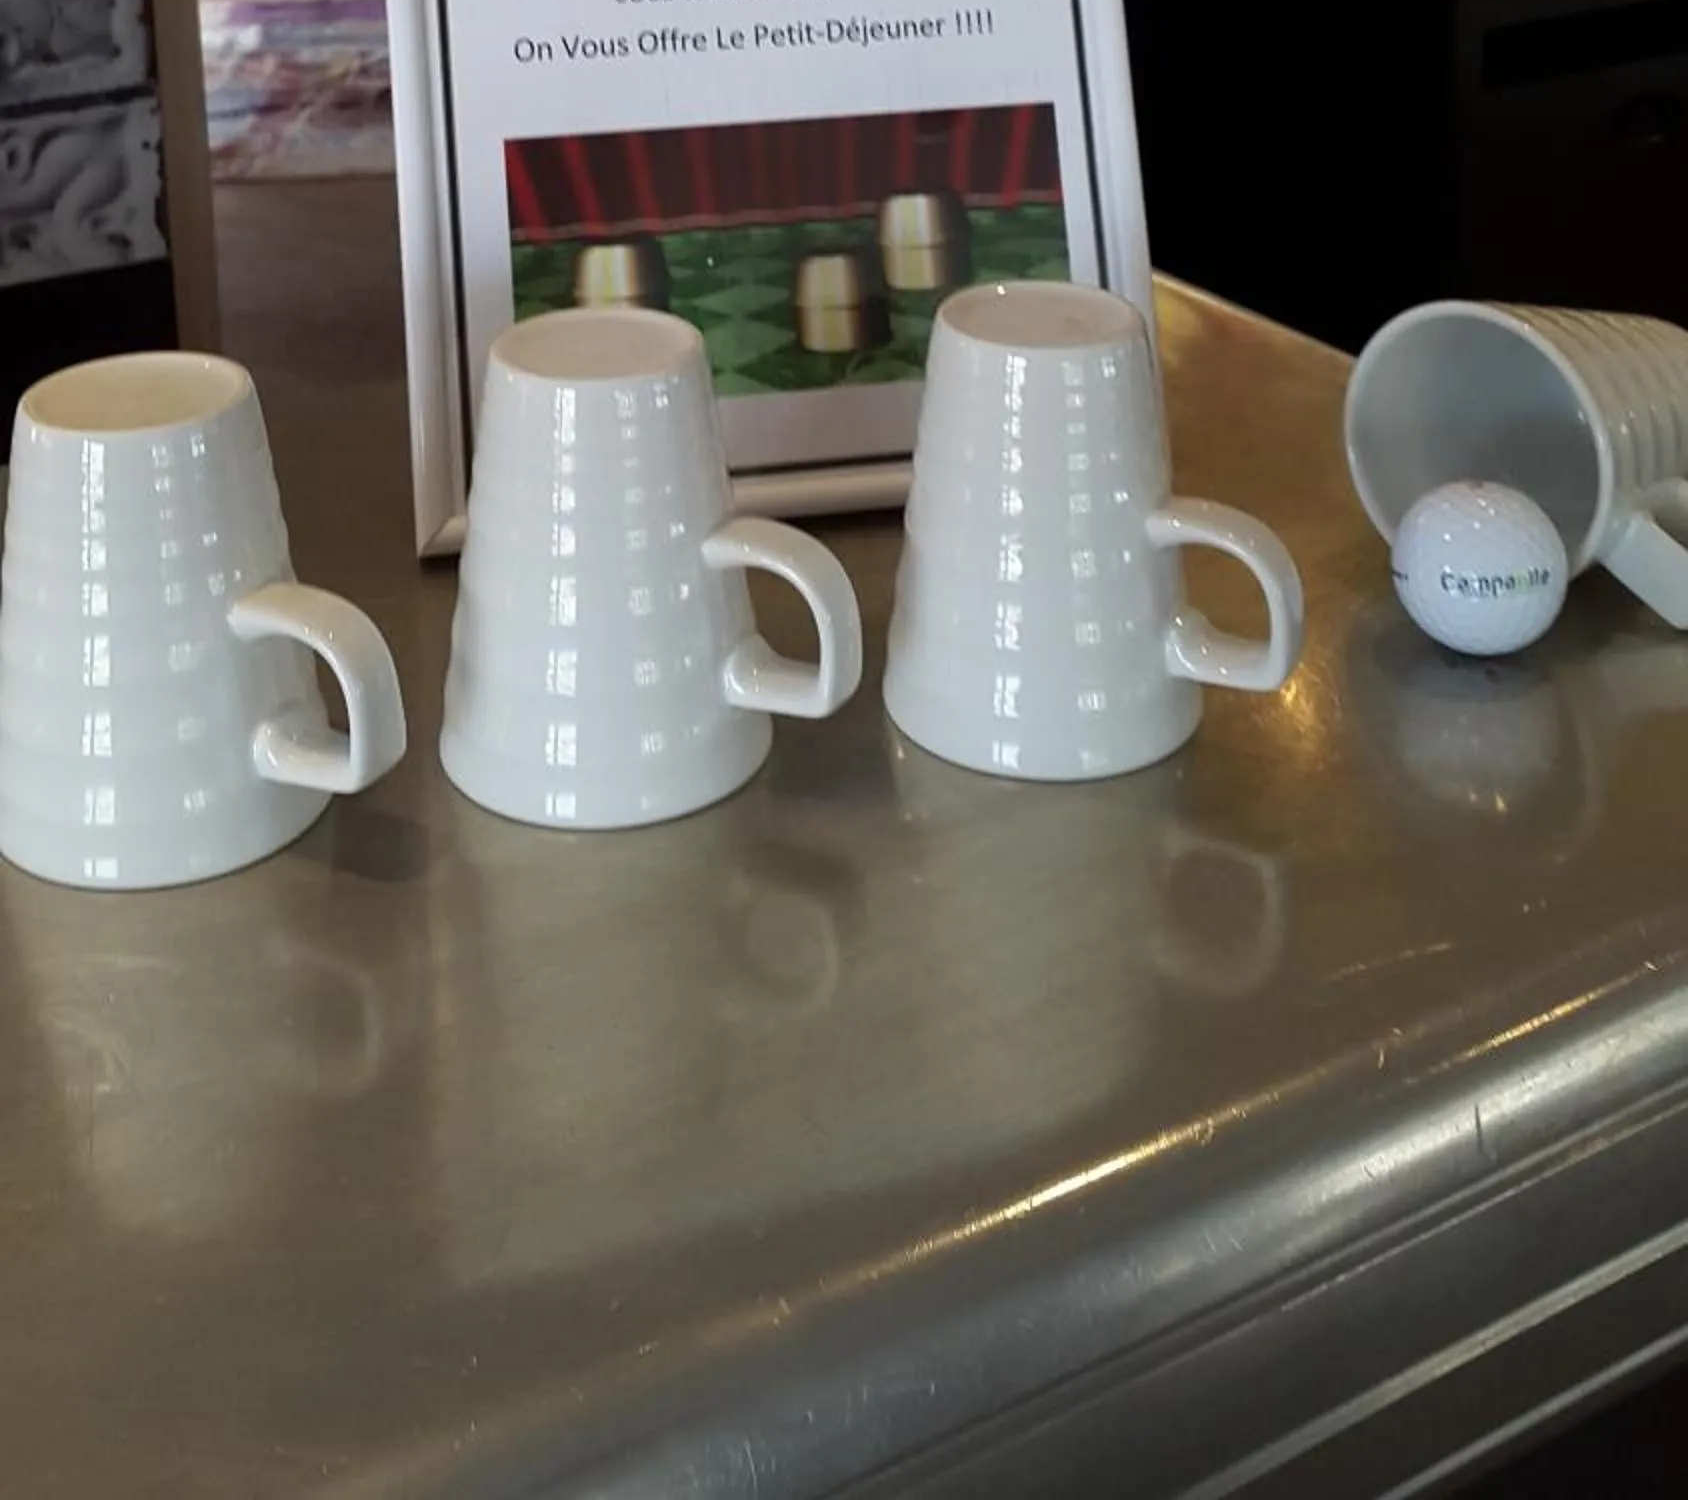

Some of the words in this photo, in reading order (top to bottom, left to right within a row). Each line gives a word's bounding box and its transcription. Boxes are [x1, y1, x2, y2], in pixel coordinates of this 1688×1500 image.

[514, 36, 554, 63] On
[560, 34, 630, 60] Vous
[637, 28, 708, 56] Offre
[716, 26, 746, 51] Le
[753, 16, 946, 50] Petit-Déjeuner
